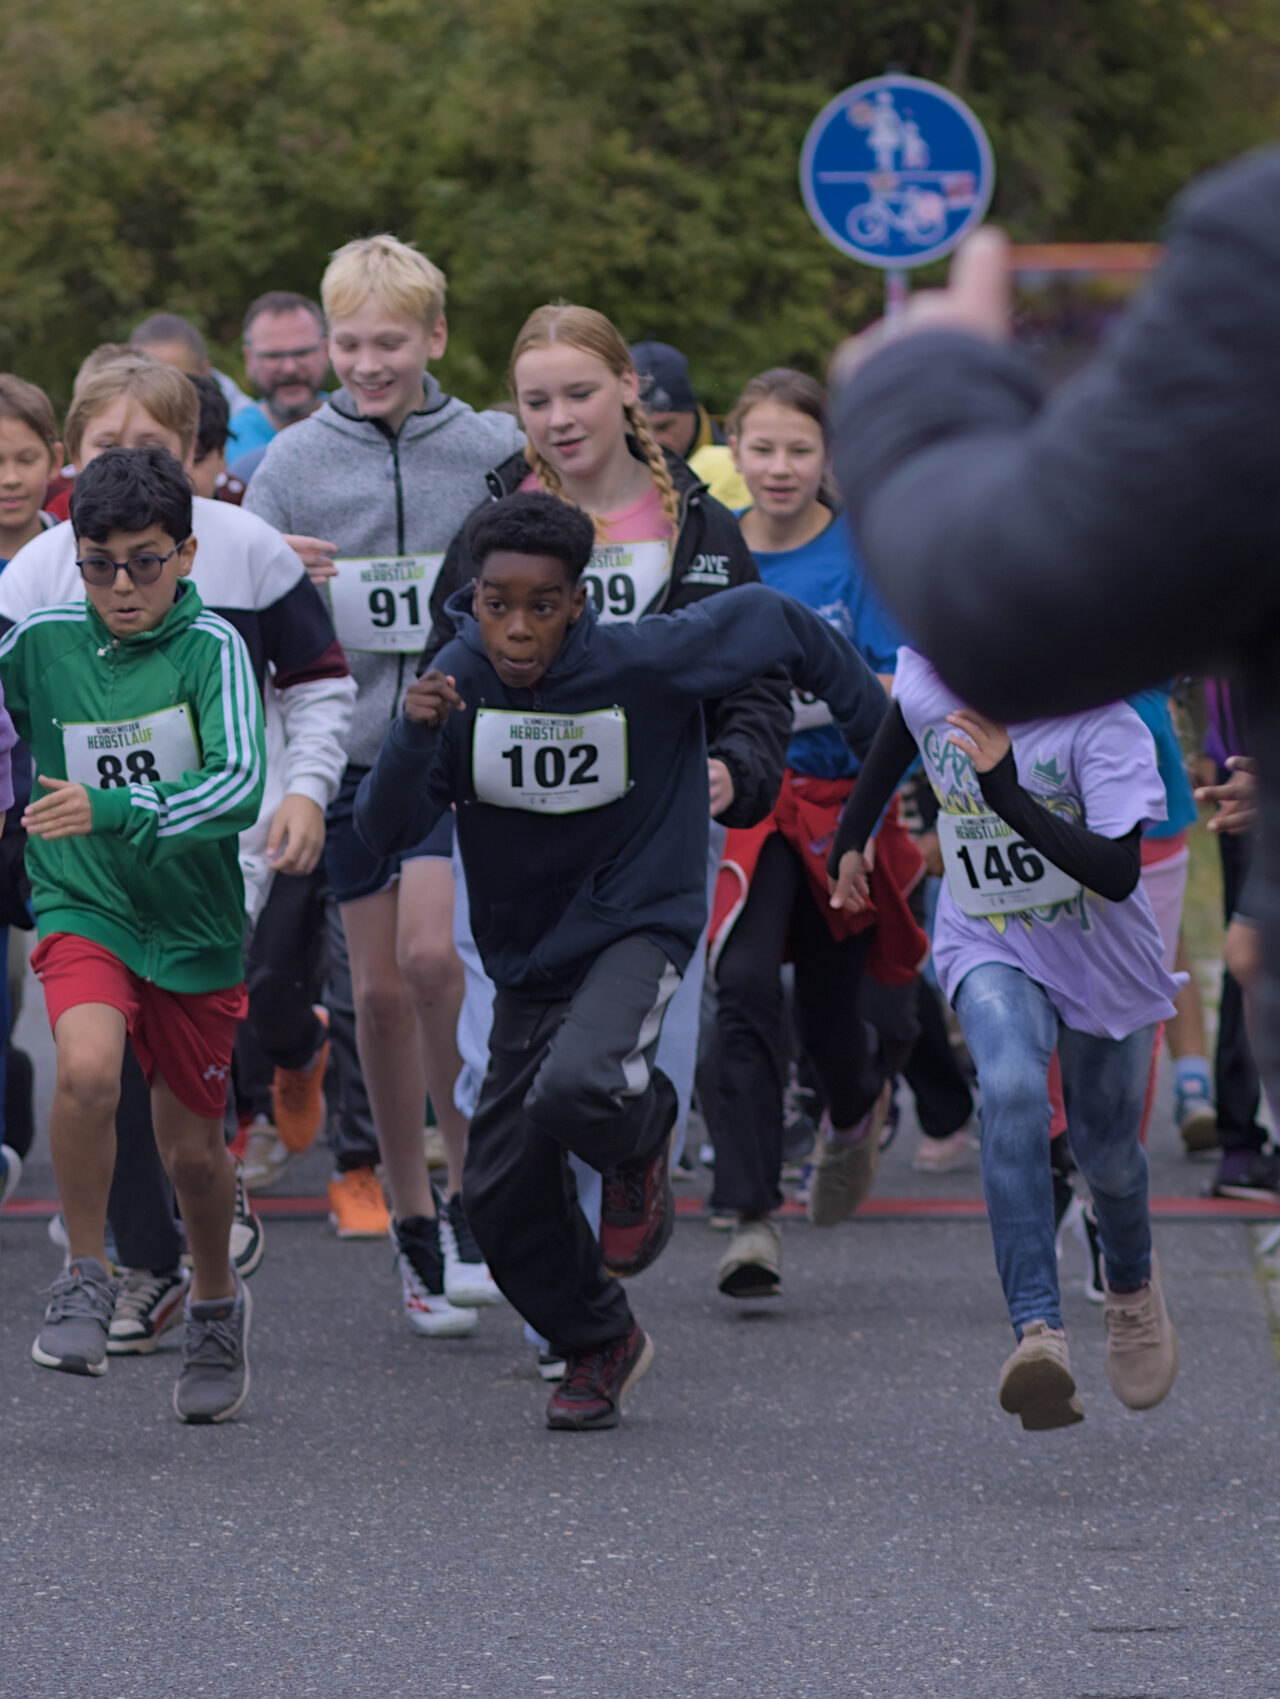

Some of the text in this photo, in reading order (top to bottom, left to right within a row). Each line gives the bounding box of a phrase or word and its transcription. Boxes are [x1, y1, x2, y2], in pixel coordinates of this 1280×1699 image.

[369, 585, 419, 628] 91
[87, 727, 153, 750] HERBSTLAUF
[510, 725, 585, 740] HERBSTLAUF
[97, 750, 161, 789] 88
[502, 743, 599, 788] 102
[957, 841, 1045, 889] 146
